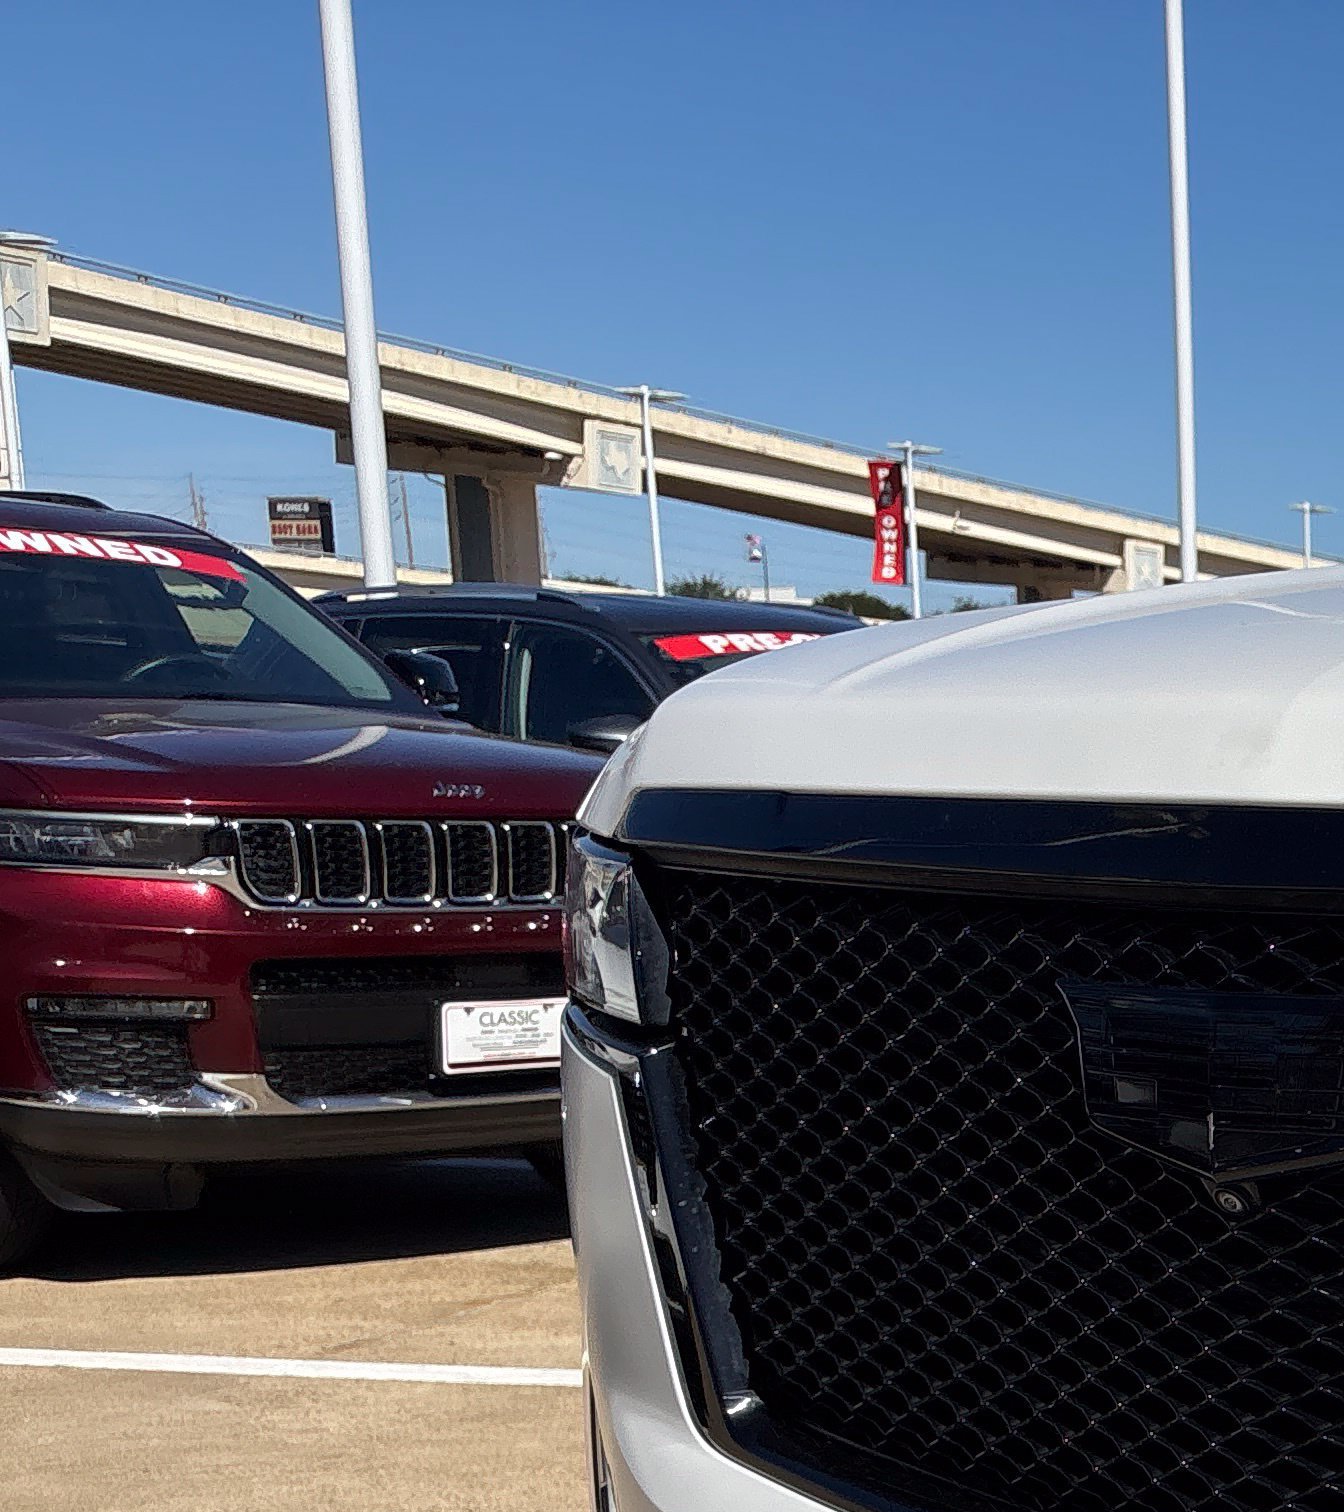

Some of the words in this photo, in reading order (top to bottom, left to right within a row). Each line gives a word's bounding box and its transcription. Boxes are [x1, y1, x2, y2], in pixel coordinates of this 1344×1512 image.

[880, 514, 898, 579] OWNED
[432, 780, 485, 799] Jeep
[478, 1009, 540, 1028] CLASSIC
